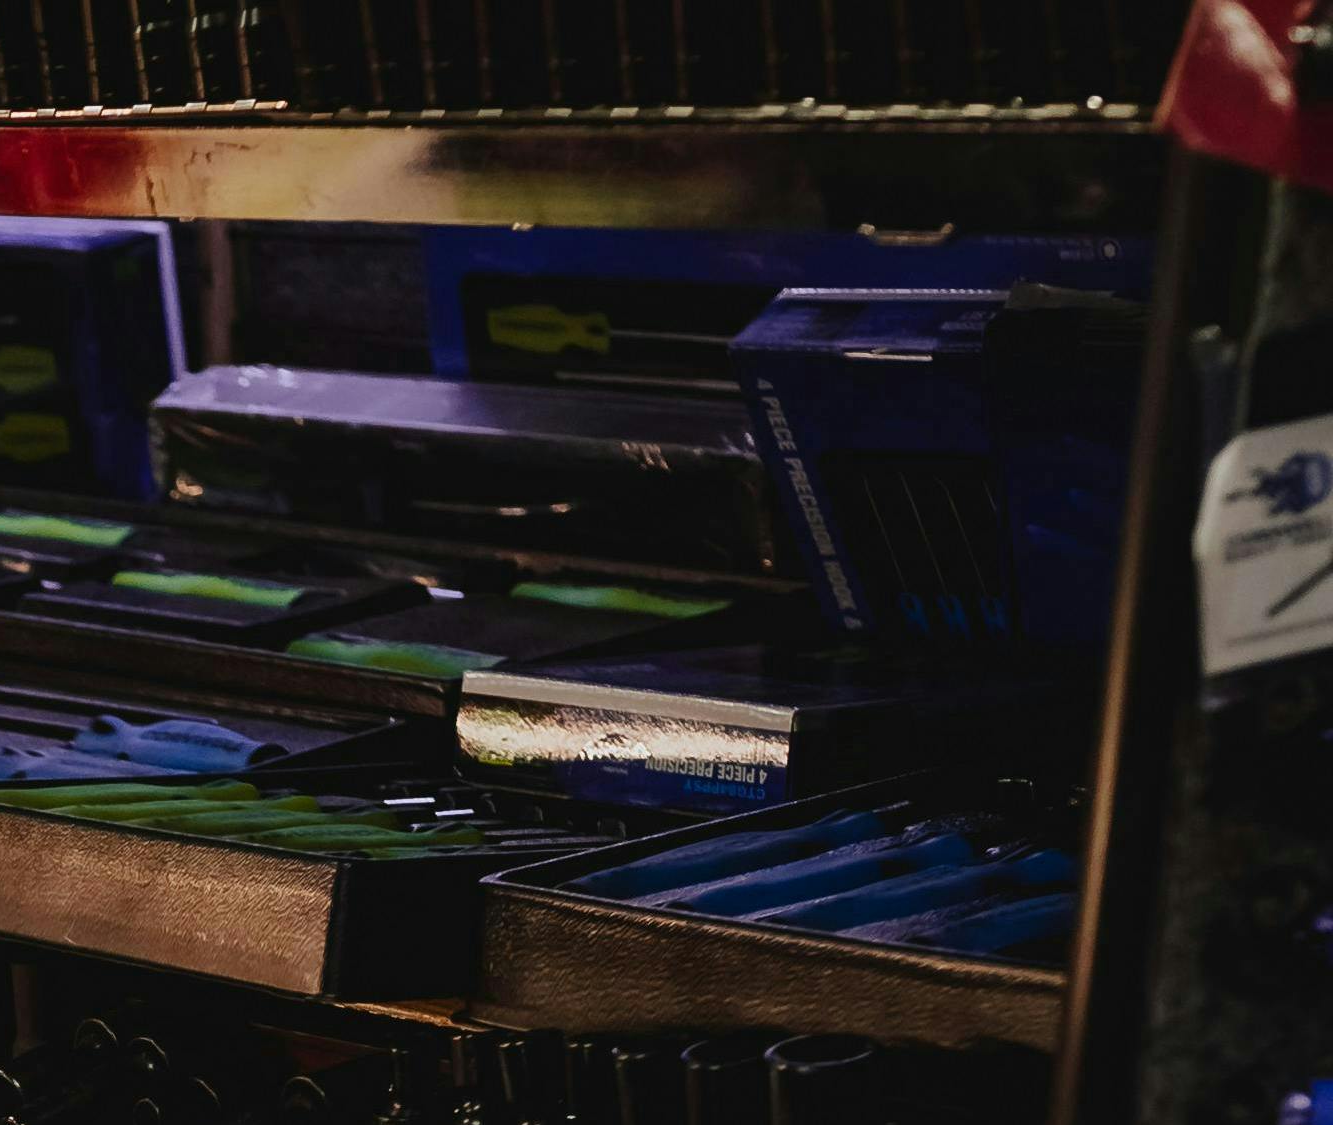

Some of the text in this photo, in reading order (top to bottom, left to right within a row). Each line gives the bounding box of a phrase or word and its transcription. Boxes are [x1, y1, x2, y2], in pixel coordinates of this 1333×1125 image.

[760, 394, 796, 455] PIECE
[783, 457, 835, 557] PRECISION
[645, 757, 768, 785] 4 PIECE PRECISION
